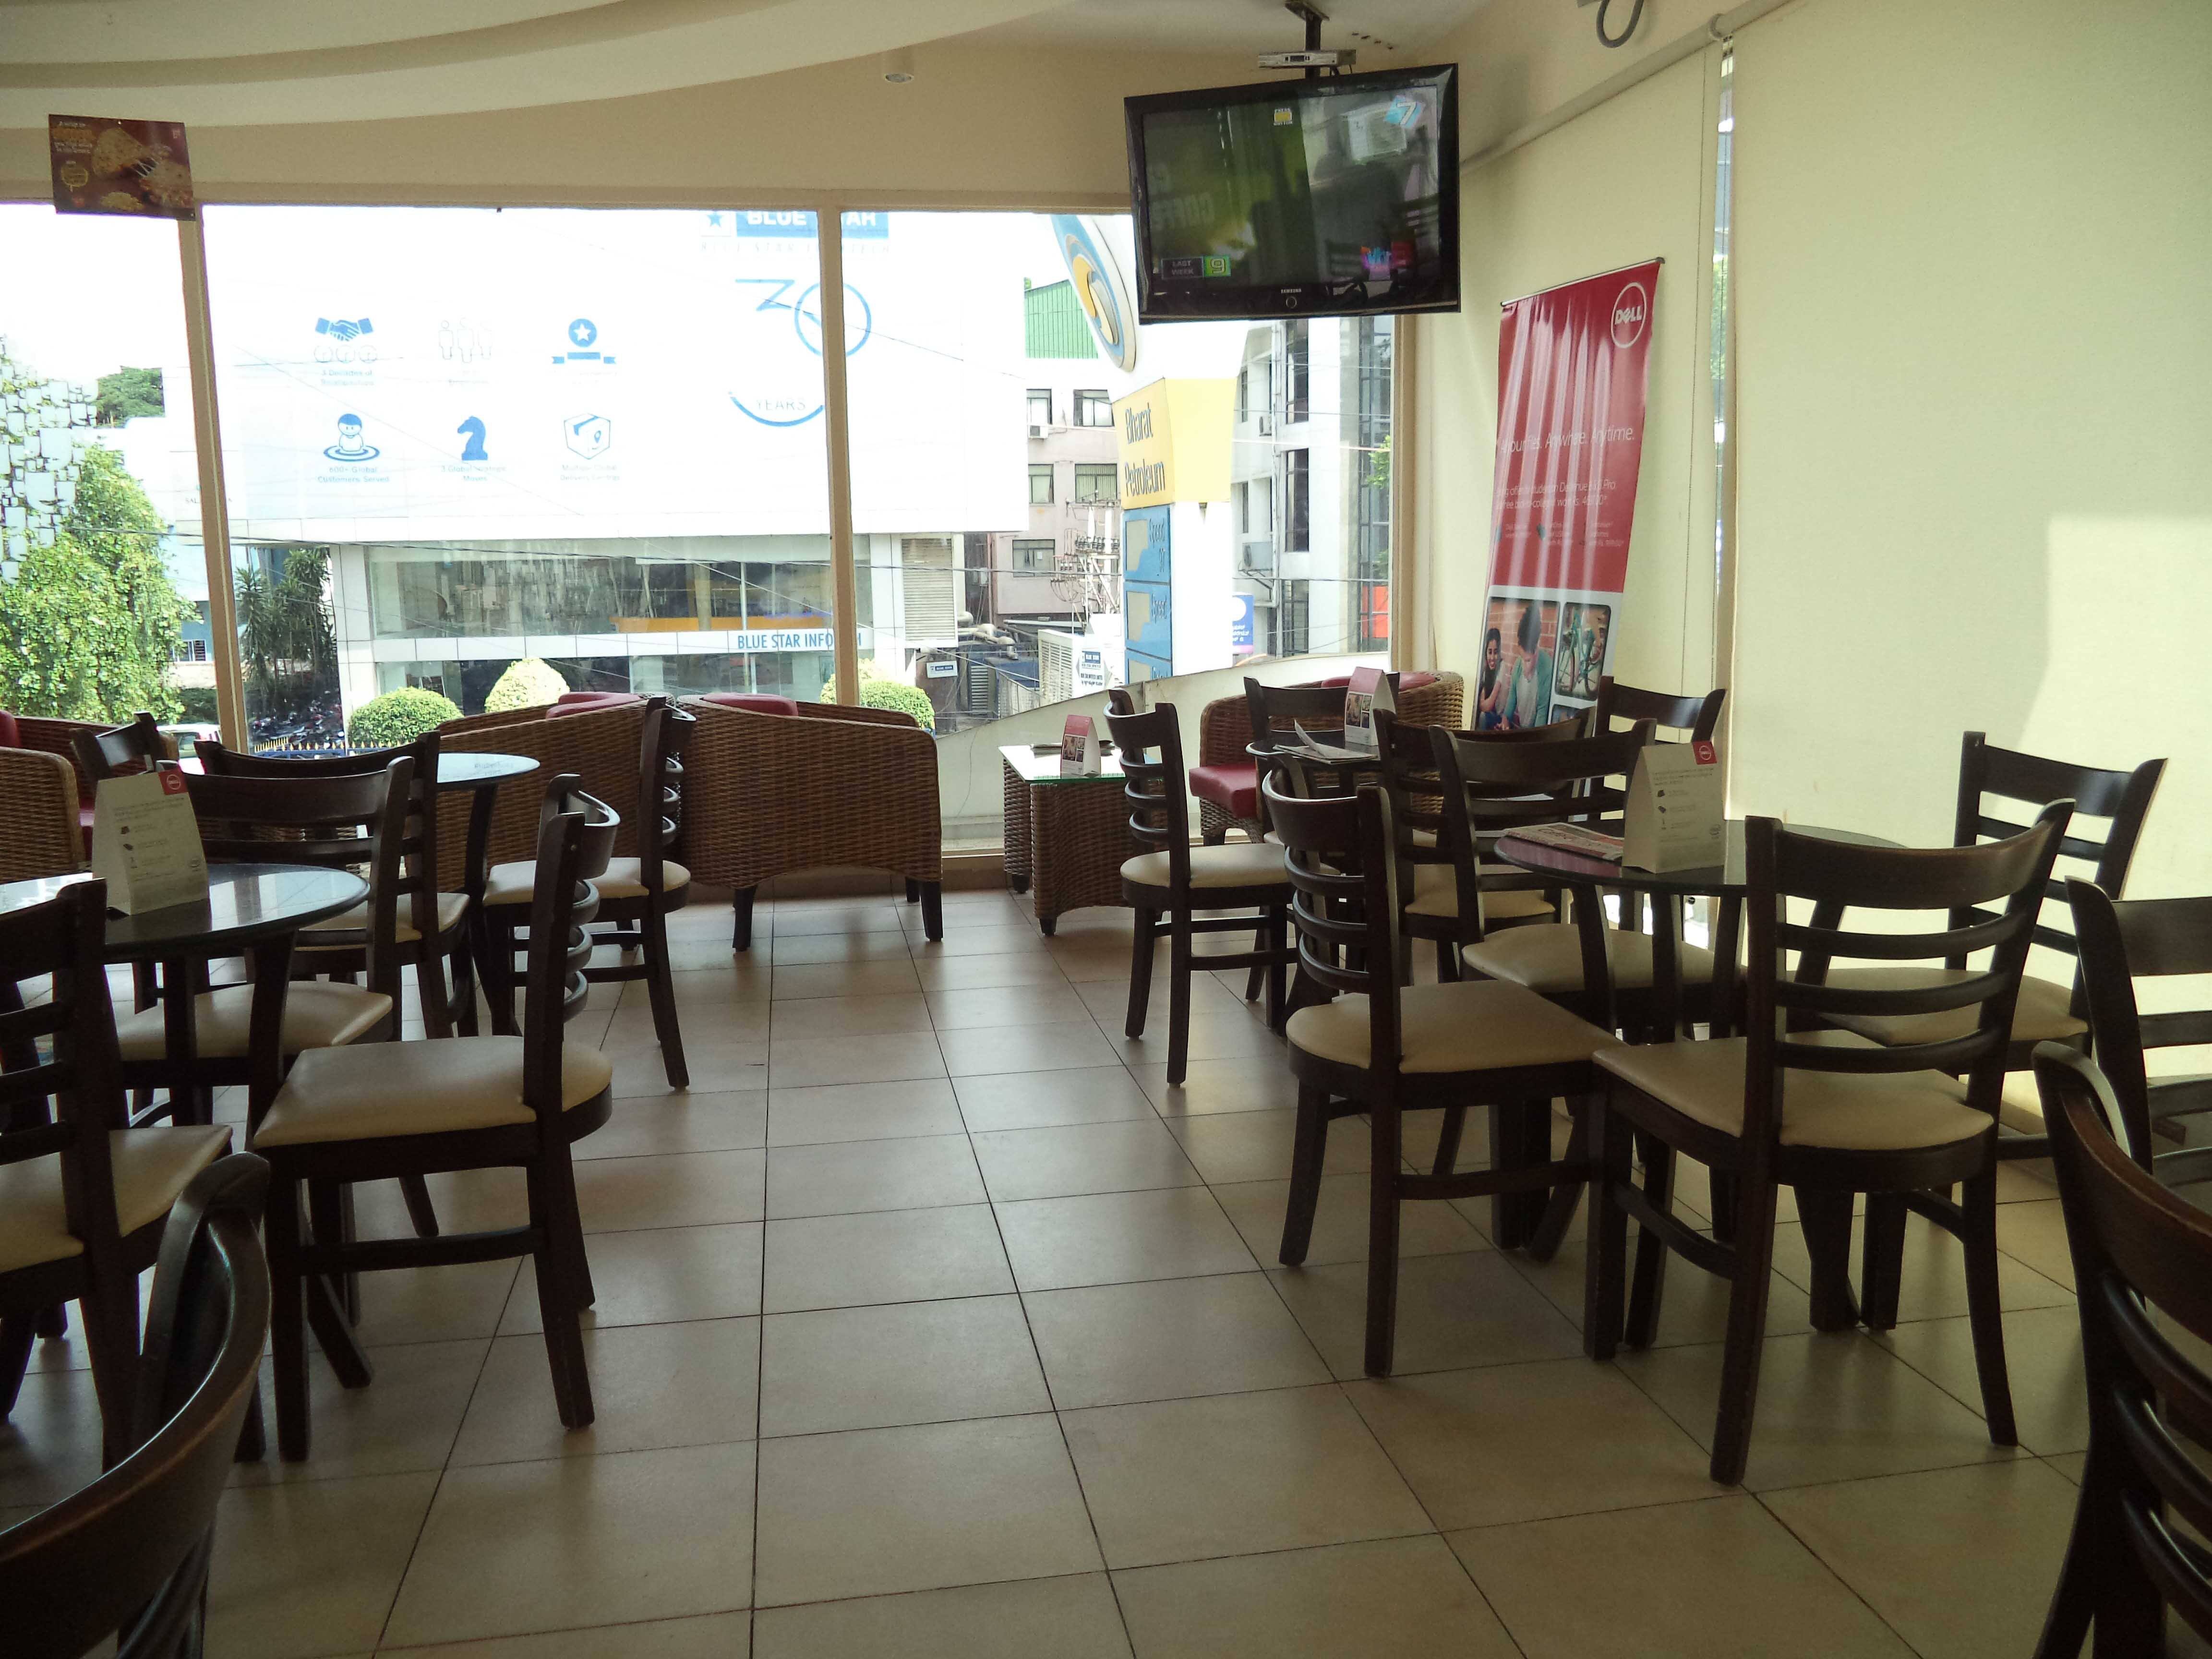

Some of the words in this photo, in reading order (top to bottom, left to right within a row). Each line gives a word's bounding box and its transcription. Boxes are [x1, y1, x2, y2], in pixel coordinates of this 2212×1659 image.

[1397, 101, 1417, 126] 7
[747, 212, 807, 226] BLUE
[1211, 258, 1226, 274] 9
[1614, 305, 1643, 325] DELL
[756, 398, 806, 411] YEARS
[1125, 402, 1154, 445] Bharat
[1124, 458, 1166, 497] Petroleum
[1149, 518, 1165, 549] Speed
[1151, 593, 1168, 624] Speed
[738, 635, 768, 649] BLUE
[771, 634, 801, 648] STAR
